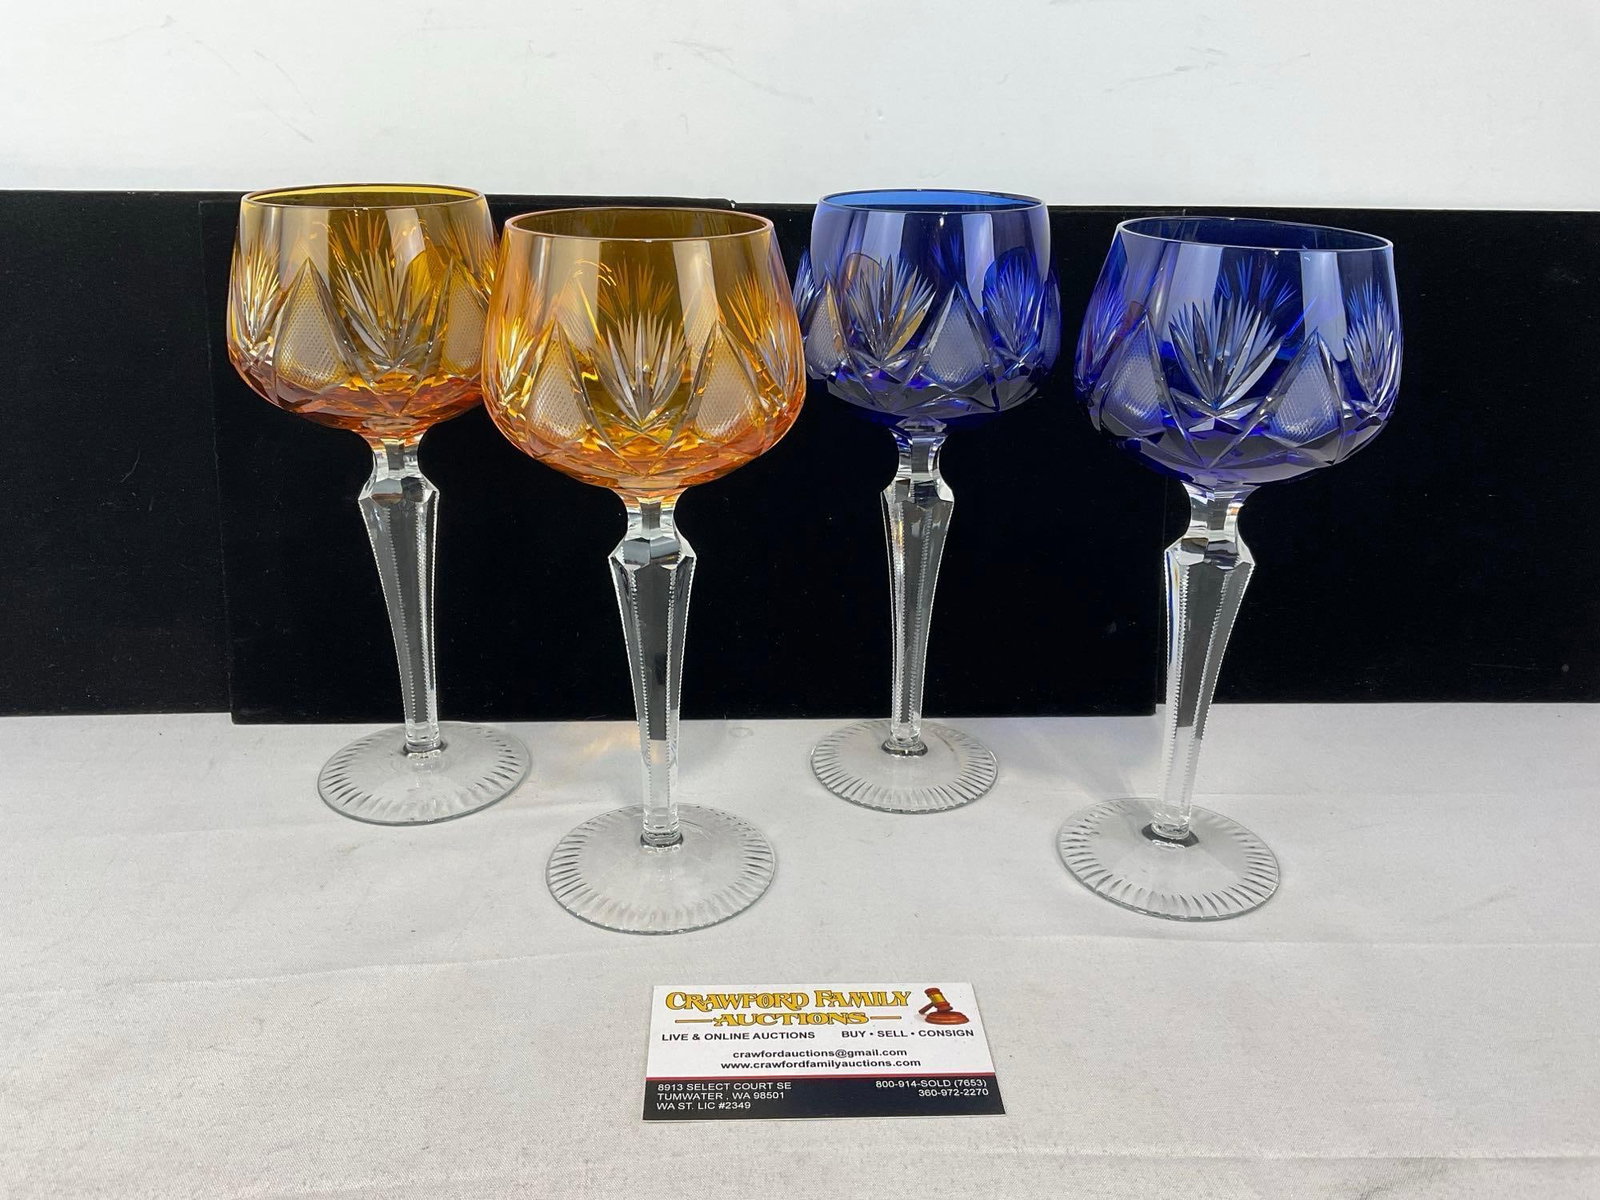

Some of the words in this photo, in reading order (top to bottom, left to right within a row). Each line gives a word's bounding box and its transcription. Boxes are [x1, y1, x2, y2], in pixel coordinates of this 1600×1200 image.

[665, 992, 809, 1012] CRAWFORD
[814, 990, 911, 1008] FAMILY
[712, 1012, 869, 1026] AUCTIONS
[662, 1033, 689, 1041] LIVE
[841, 1030, 866, 1038] BUY
[877, 1030, 908, 1038] SELL
[918, 1029, 974, 1037] CONSIGN
[732, 1049, 907, 1058] crawfordauctions@gmail.com
[721, 1060, 921, 1069] www.crawfordfamilyauctions.com
[658, 1083, 683, 1091] 8913
[733, 1082, 773, 1090] COURT
[777, 1082, 792, 1090] SE
[875, 1080, 950, 1088] 800-914-SOLD
[954, 1079, 987, 1088] (7653)
[918, 1089, 989, 1097] 360-972-2270
[657, 1102, 675, 1110] WA
[678, 1102, 694, 1110] ST.
[698, 1102, 715, 1110] LIC
